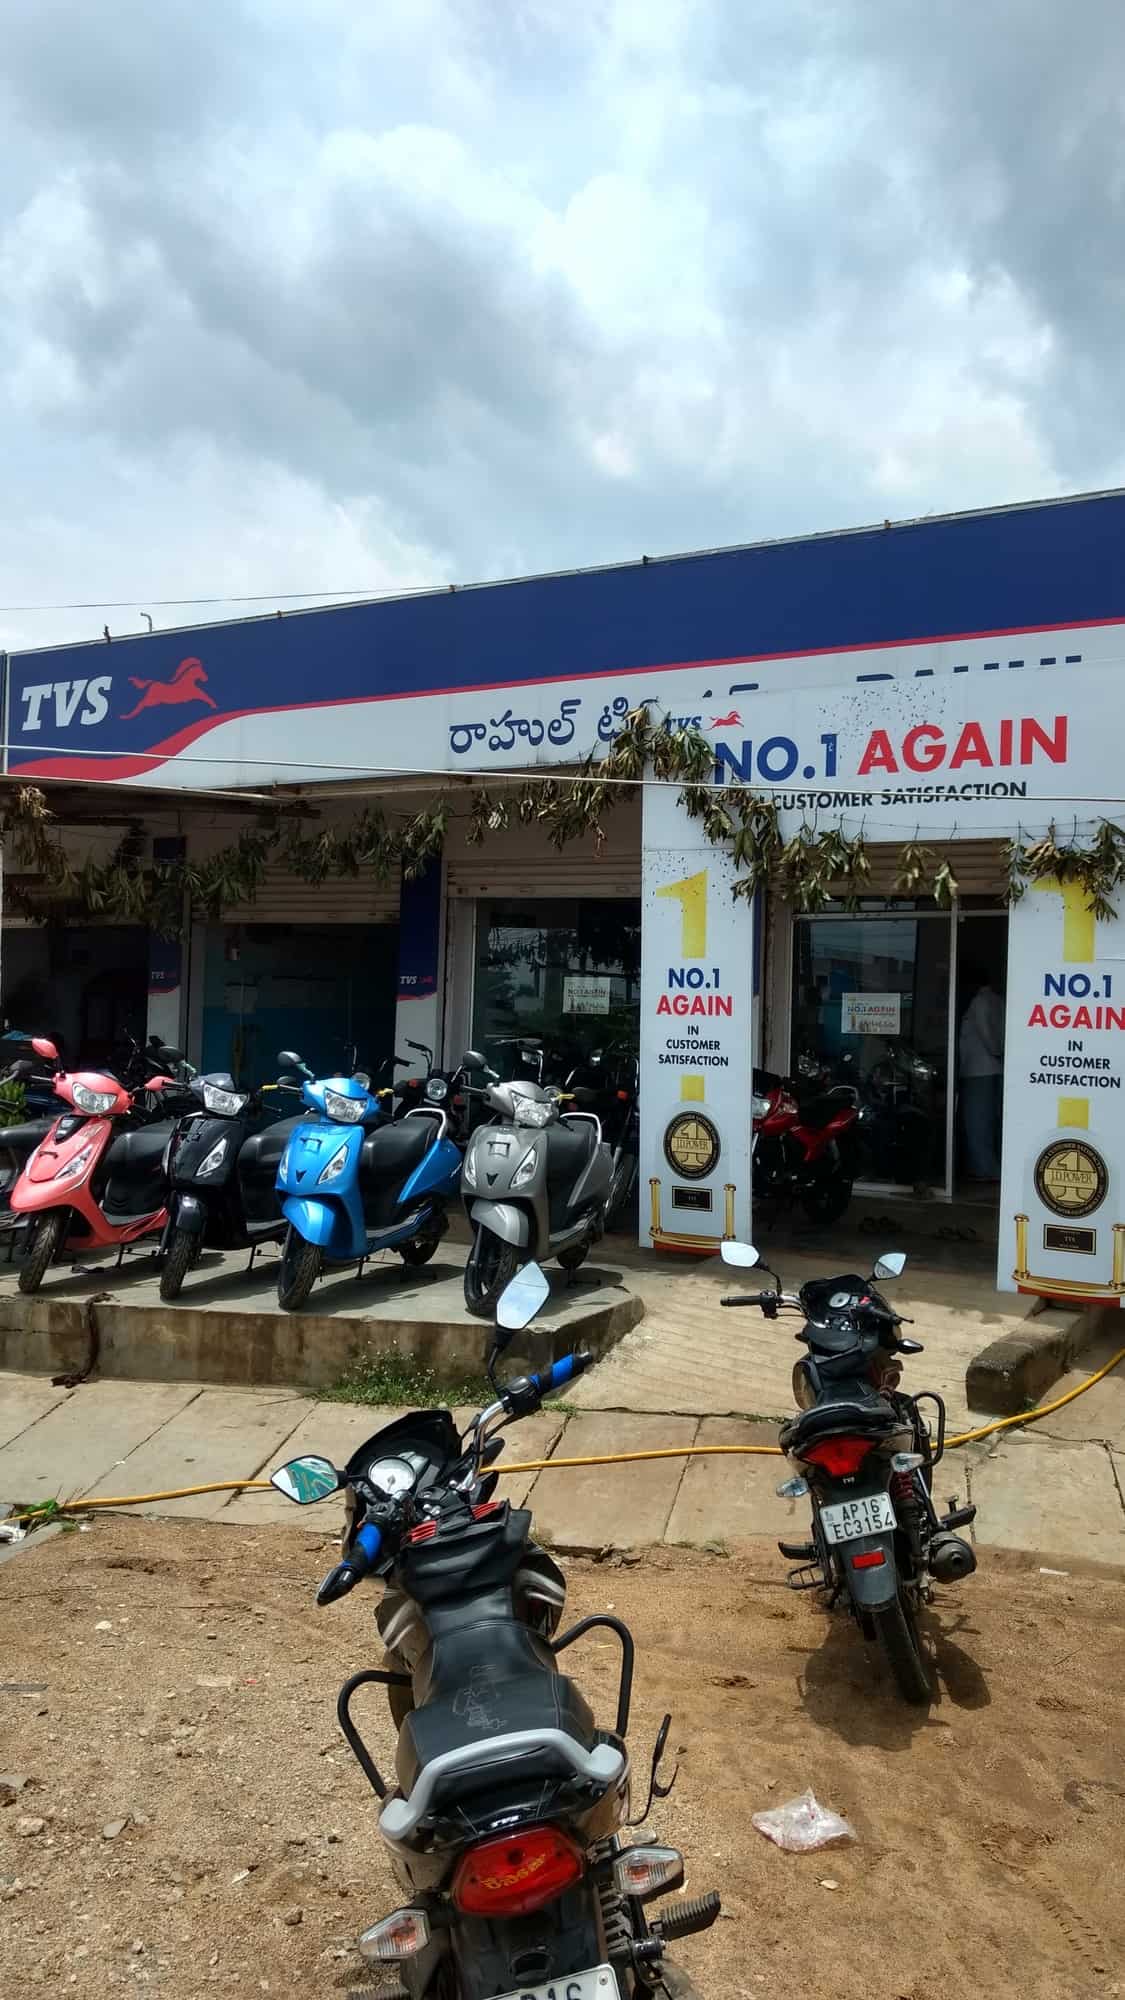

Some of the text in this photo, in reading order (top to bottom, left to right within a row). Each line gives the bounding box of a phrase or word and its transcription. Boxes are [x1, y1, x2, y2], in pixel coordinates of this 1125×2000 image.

[21, 676, 112, 731] TVS
[450, 699, 581, 753] రాహుల్
[662, 715, 702, 736] TVS
[714, 715, 1068, 784] NO.1 AGAIN
[773, 791, 873, 810] CUSTOMER
[881, 781, 1027, 805] SATISFACTION
[400, 976, 417, 984] TVS
[668, 968, 720, 989] NO.1
[1044, 973, 1113, 998] NO.1
[656, 994, 733, 1016] AGAIN
[1027, 1004, 1125, 1031] AGAIN
[687, 1025, 699, 1035] IN
[666, 1039, 721, 1051] CUSTOMER
[1067, 1040, 1083, 1051] IN
[658, 1054, 729, 1067] SATISFACTION
[1040, 1056, 1111, 1070] CUSTOMER
[1029, 1073, 1121, 1088] SATISFACTION
[833, 1512, 894, 1539] EC3154
